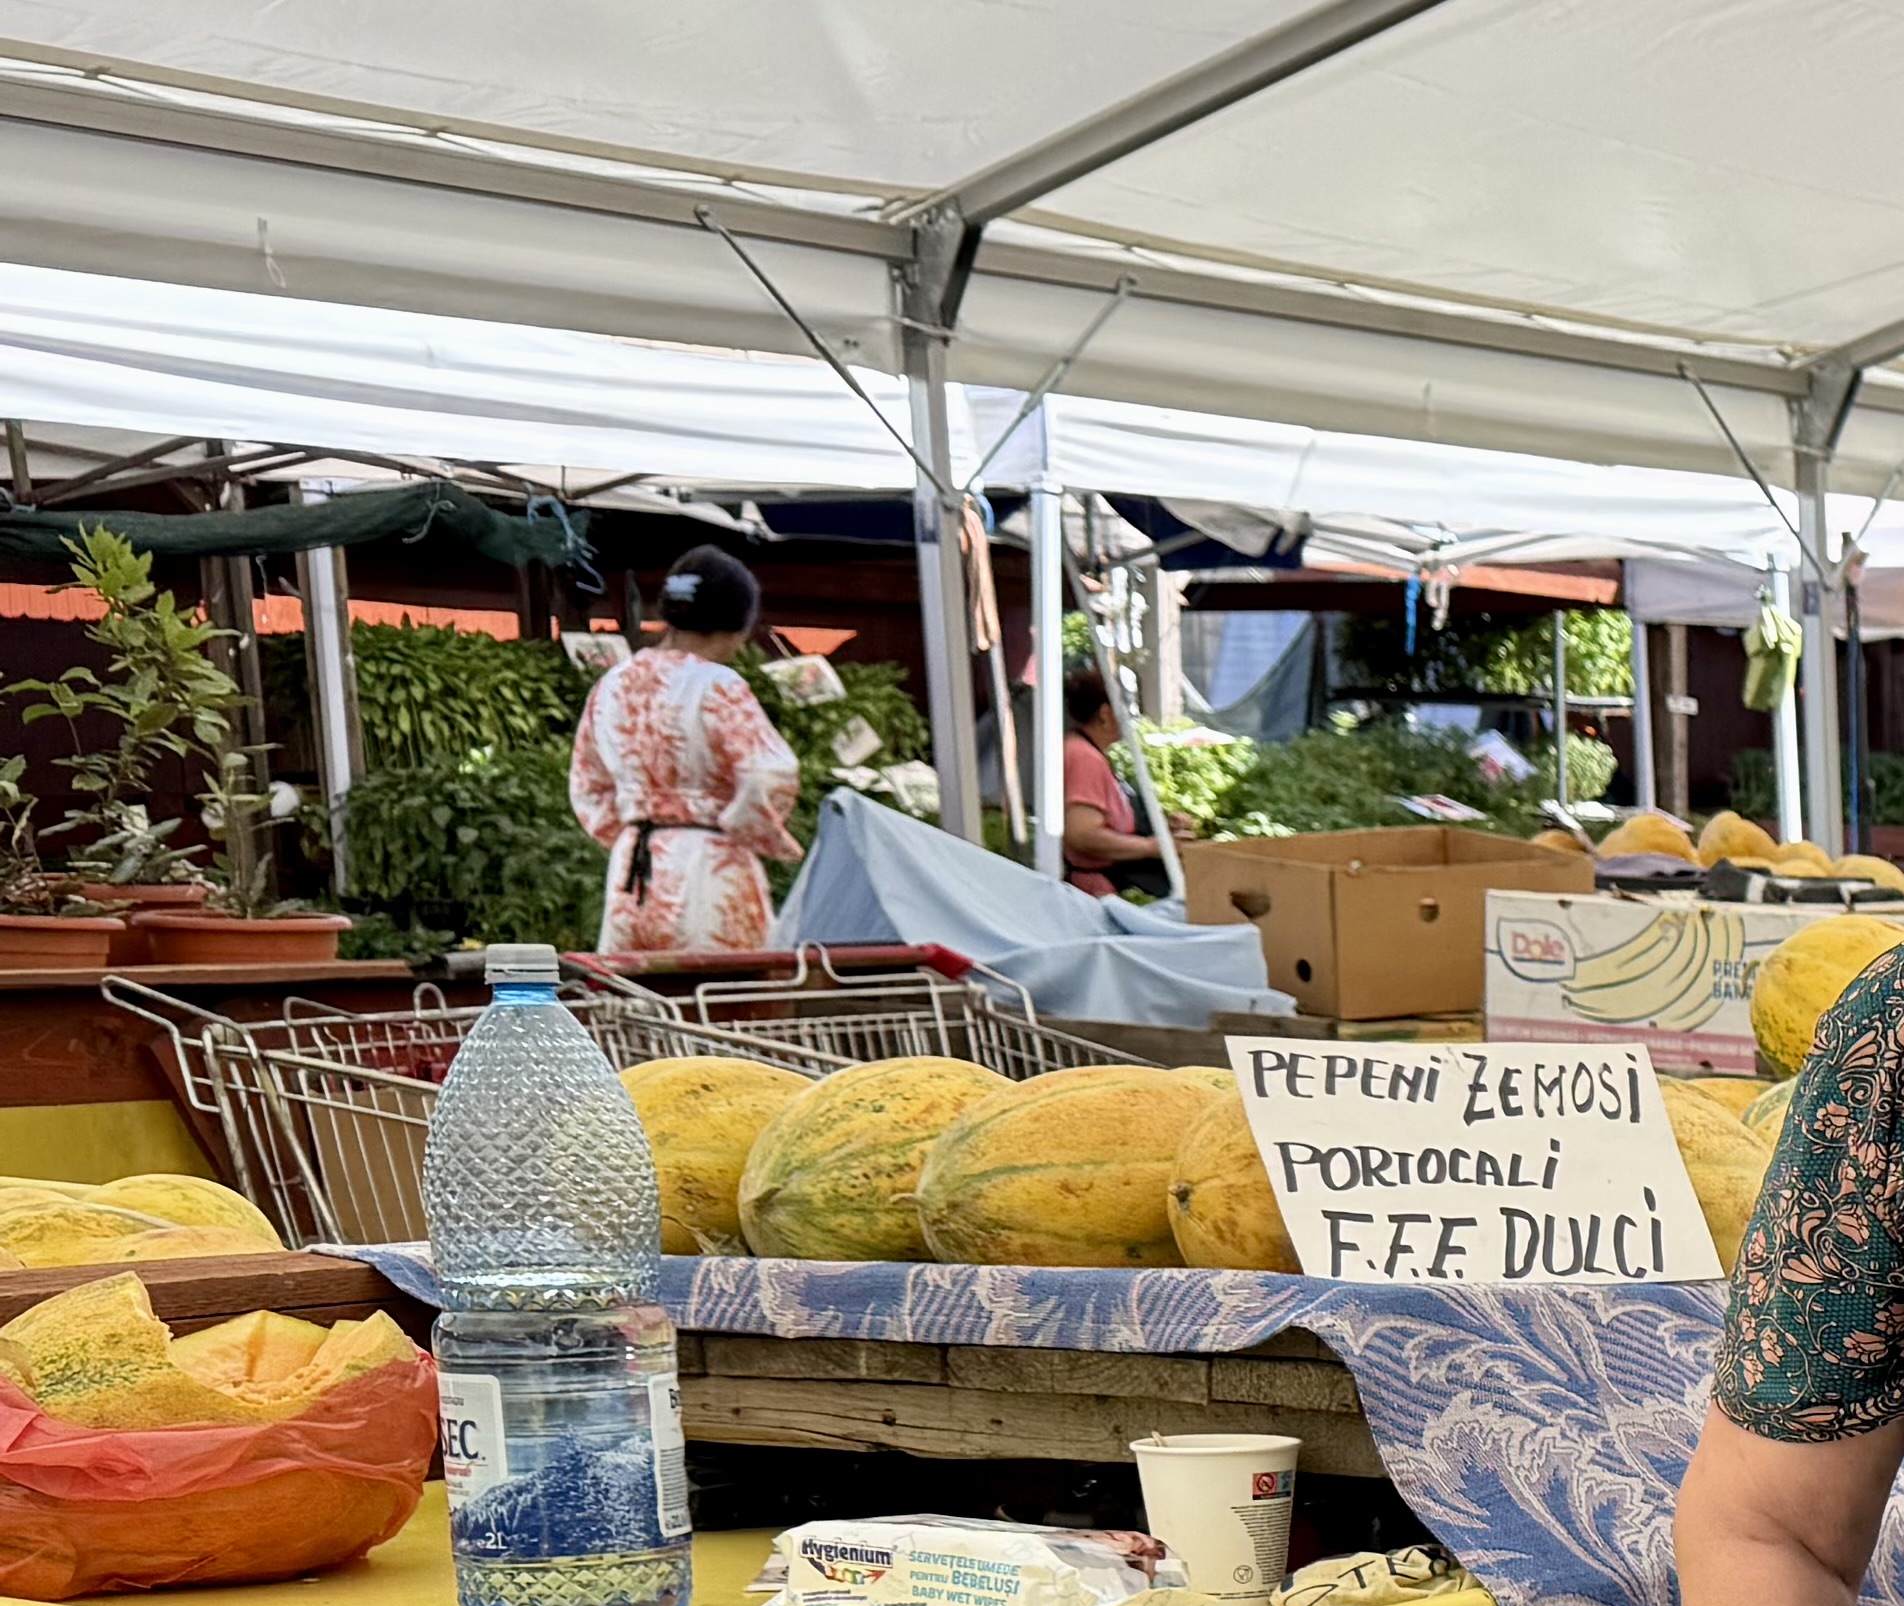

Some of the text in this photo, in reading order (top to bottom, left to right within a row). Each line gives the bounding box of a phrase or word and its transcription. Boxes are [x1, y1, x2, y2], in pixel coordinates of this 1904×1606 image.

[1511, 930, 1565, 957] Dole
[1247, 1050, 1441, 1103] PEPENI
[1274, 1138, 1561, 1194] PORTOCALI
[1499, 1186, 1664, 1279] DULCI
[801, 1538, 892, 1566] Hygienium
[912, 1585, 944, 1600] BABY
[946, 1588, 973, 1605] WET
